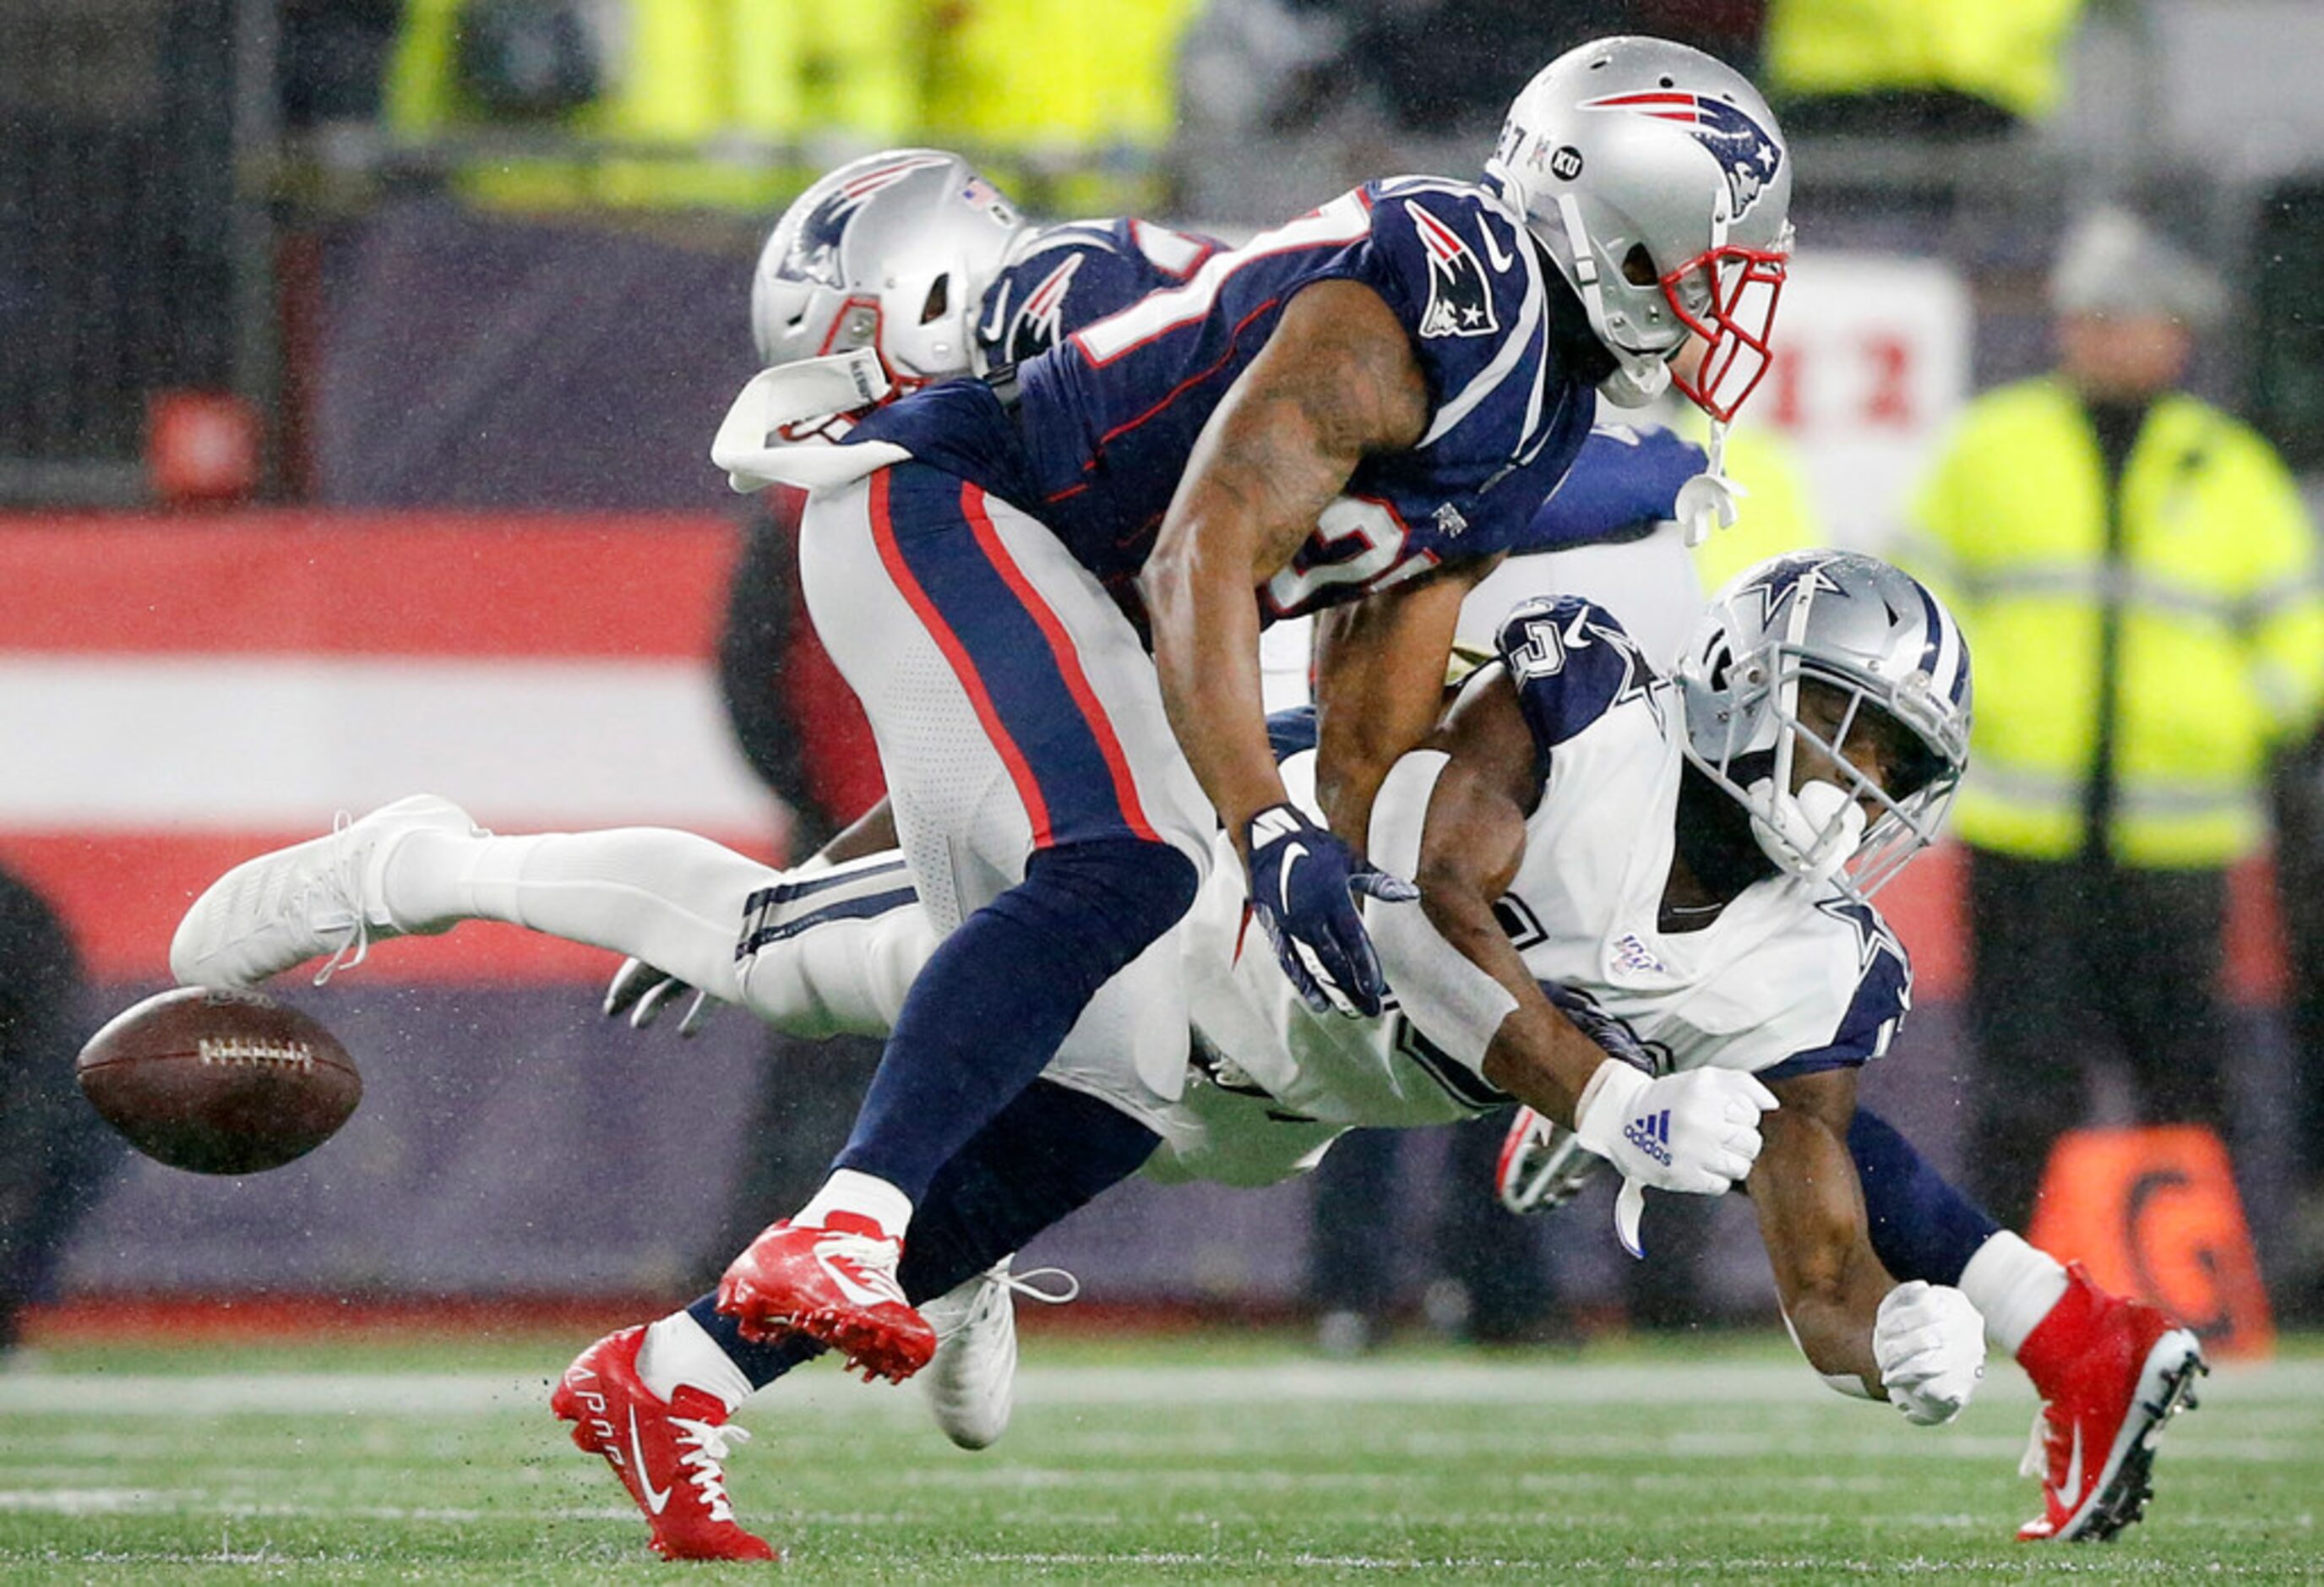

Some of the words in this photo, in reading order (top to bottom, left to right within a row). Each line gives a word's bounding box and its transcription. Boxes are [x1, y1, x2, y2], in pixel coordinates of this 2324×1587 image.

[1554, 149, 1581, 177] KU
[1624, 1124, 1673, 1167] adidas
[2120, 1168, 2234, 1342] G
